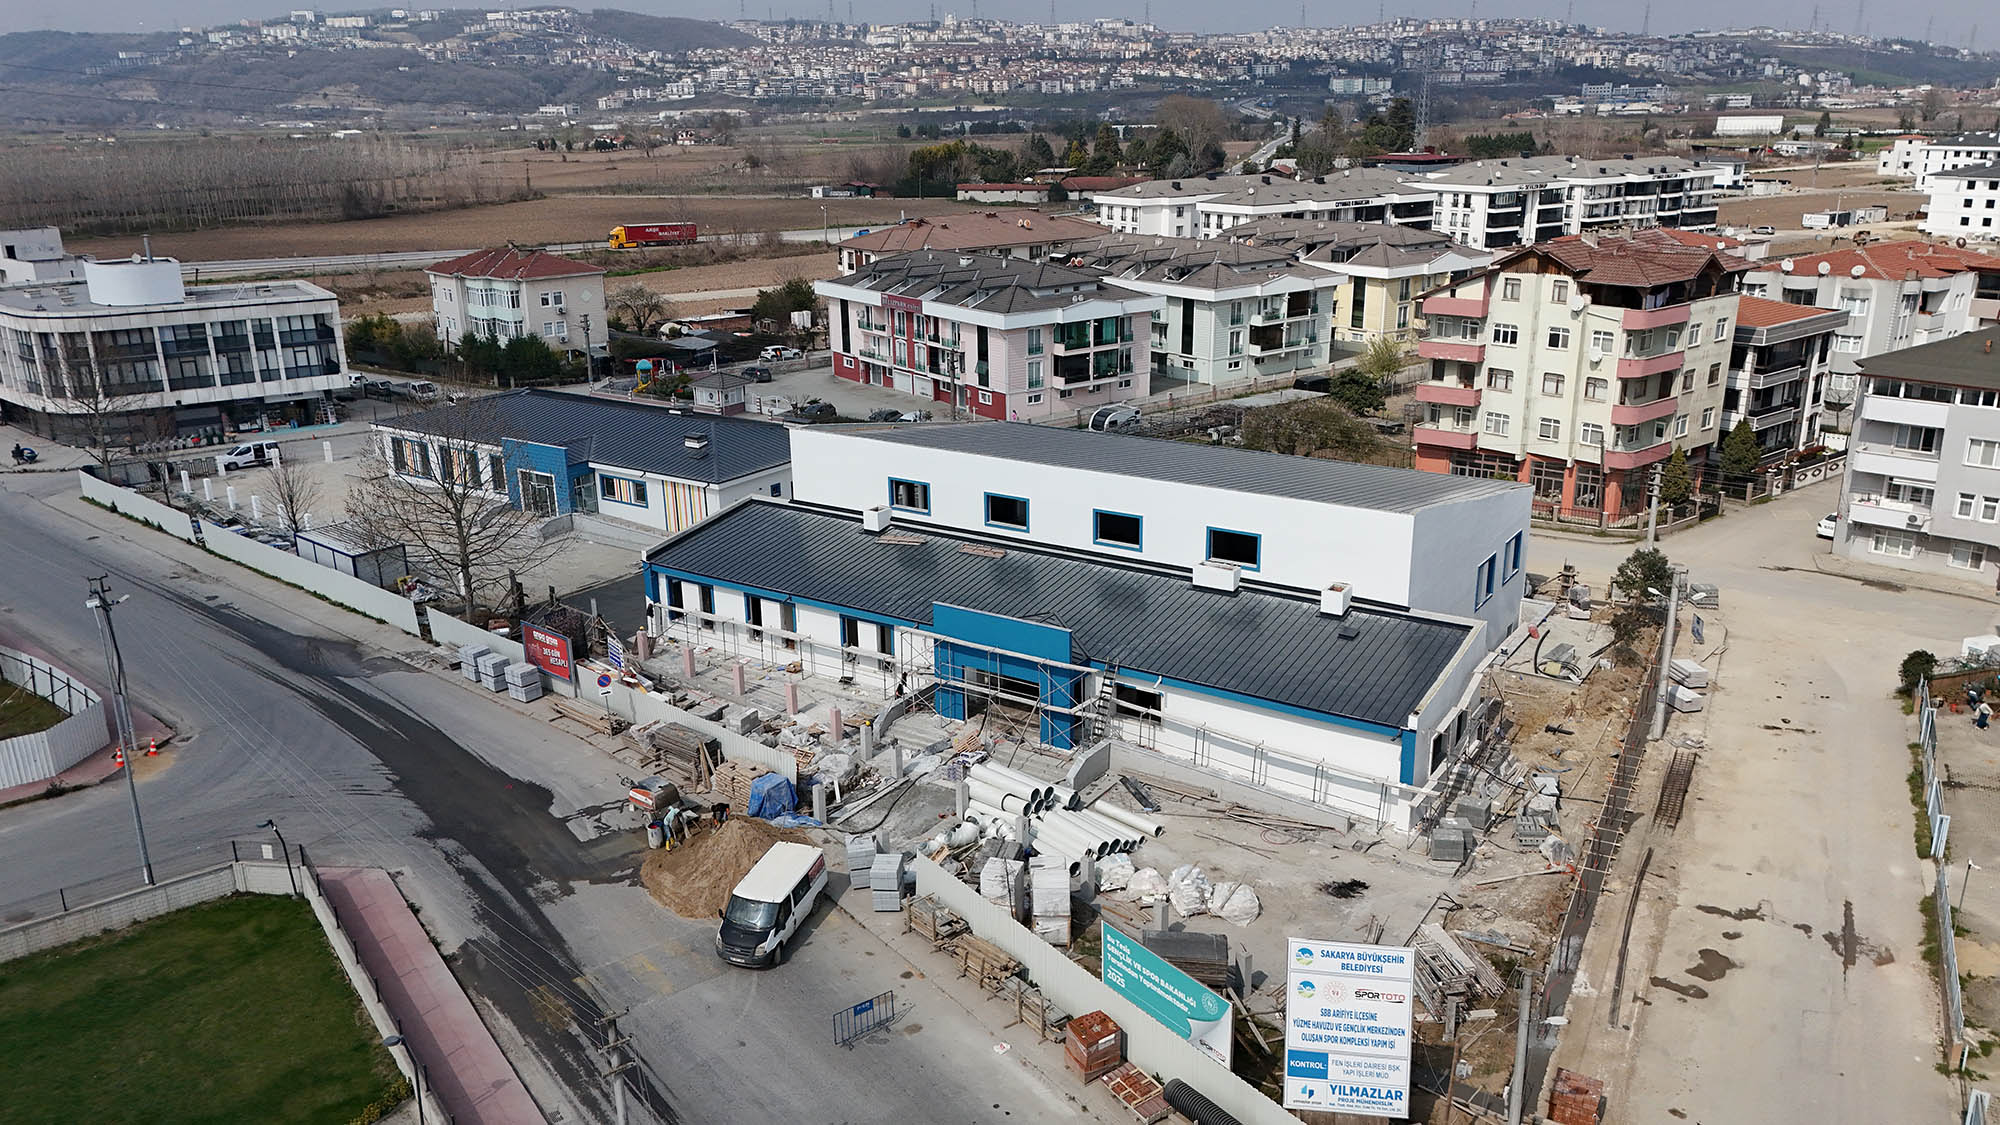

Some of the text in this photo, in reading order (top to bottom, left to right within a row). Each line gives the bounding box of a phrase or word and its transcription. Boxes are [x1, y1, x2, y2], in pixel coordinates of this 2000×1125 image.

[1115, 940, 1131, 955] Tesis
[1320, 949, 1405, 964] SAKARYA BÜYÜKŞEHİR
[1341, 962, 1383, 974] BELEDİYESİ
[1106, 968, 1126, 989] 2025
[1133, 960, 1142, 972] VE
[1142, 966, 1160, 984] SPOR
[1160, 978, 1197, 1008] BAKANLIĞI
[1320, 1007, 1378, 1022] SBB ARİFİYE İLÇESİNE
[1293, 1018, 1406, 1037] YÜZME HAVUZU VE GENÇLİK MERKEZİNDEN
[1301, 1033, 1396, 1050] OLUŞAN SPOR KOMPLEKSİ YAPIM İŞİ
[1290, 1059, 1328, 1069] KONTROL:
[1331, 1059, 1344, 1067] FEN
[1344, 1059, 1363, 1069] İŞLERİ
[1363, 1061, 1387, 1071] DAİRESİ
[1343, 1069, 1356, 1078] YAPI
[1356, 1069, 1375, 1079] İŞLERİ
[1329, 1084, 1404, 1101] YILMAZLAR
[1355, 1098, 1393, 1107] MÜHENDİSLİK
